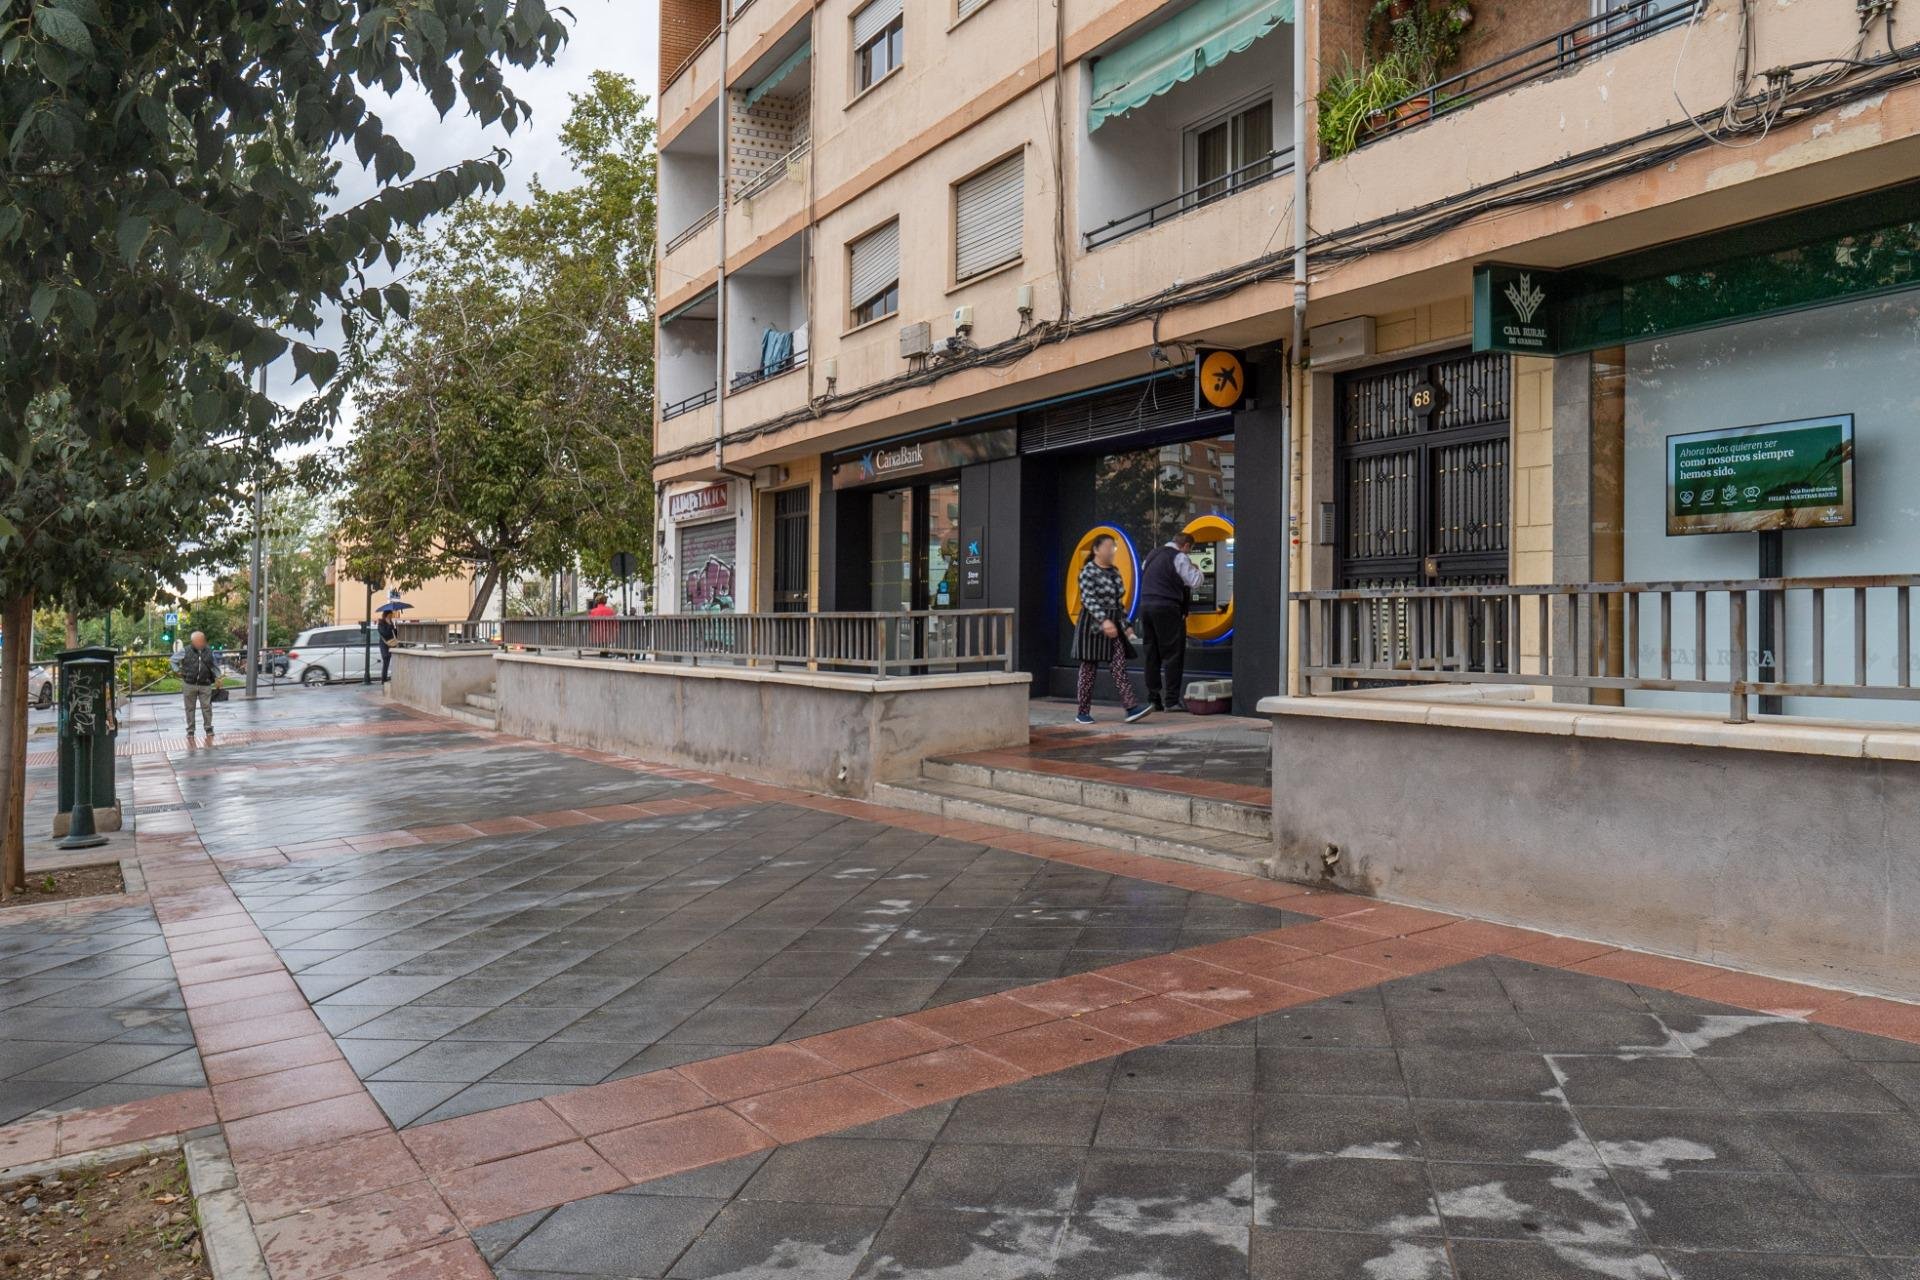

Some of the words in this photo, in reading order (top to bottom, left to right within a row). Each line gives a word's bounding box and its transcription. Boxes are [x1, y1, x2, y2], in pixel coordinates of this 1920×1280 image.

[1503, 326, 1521, 336] CAJA
[1522, 327, 1547, 338] RURAL
[1414, 390, 1430, 407] 68
[876, 442, 923, 470] CaixaBank
[1680, 448, 1705, 459] Ahora
[1706, 444, 1729, 455] todos
[1730, 441, 1762, 454] quieren
[1764, 440, 1778, 449] ser
[1680, 458, 1706, 468] como
[1707, 453, 1751, 466] nosotros
[1752, 449, 1795, 461] siempre
[1680, 469, 1712, 480] hemos
[1713, 466, 1737, 477] sido.
